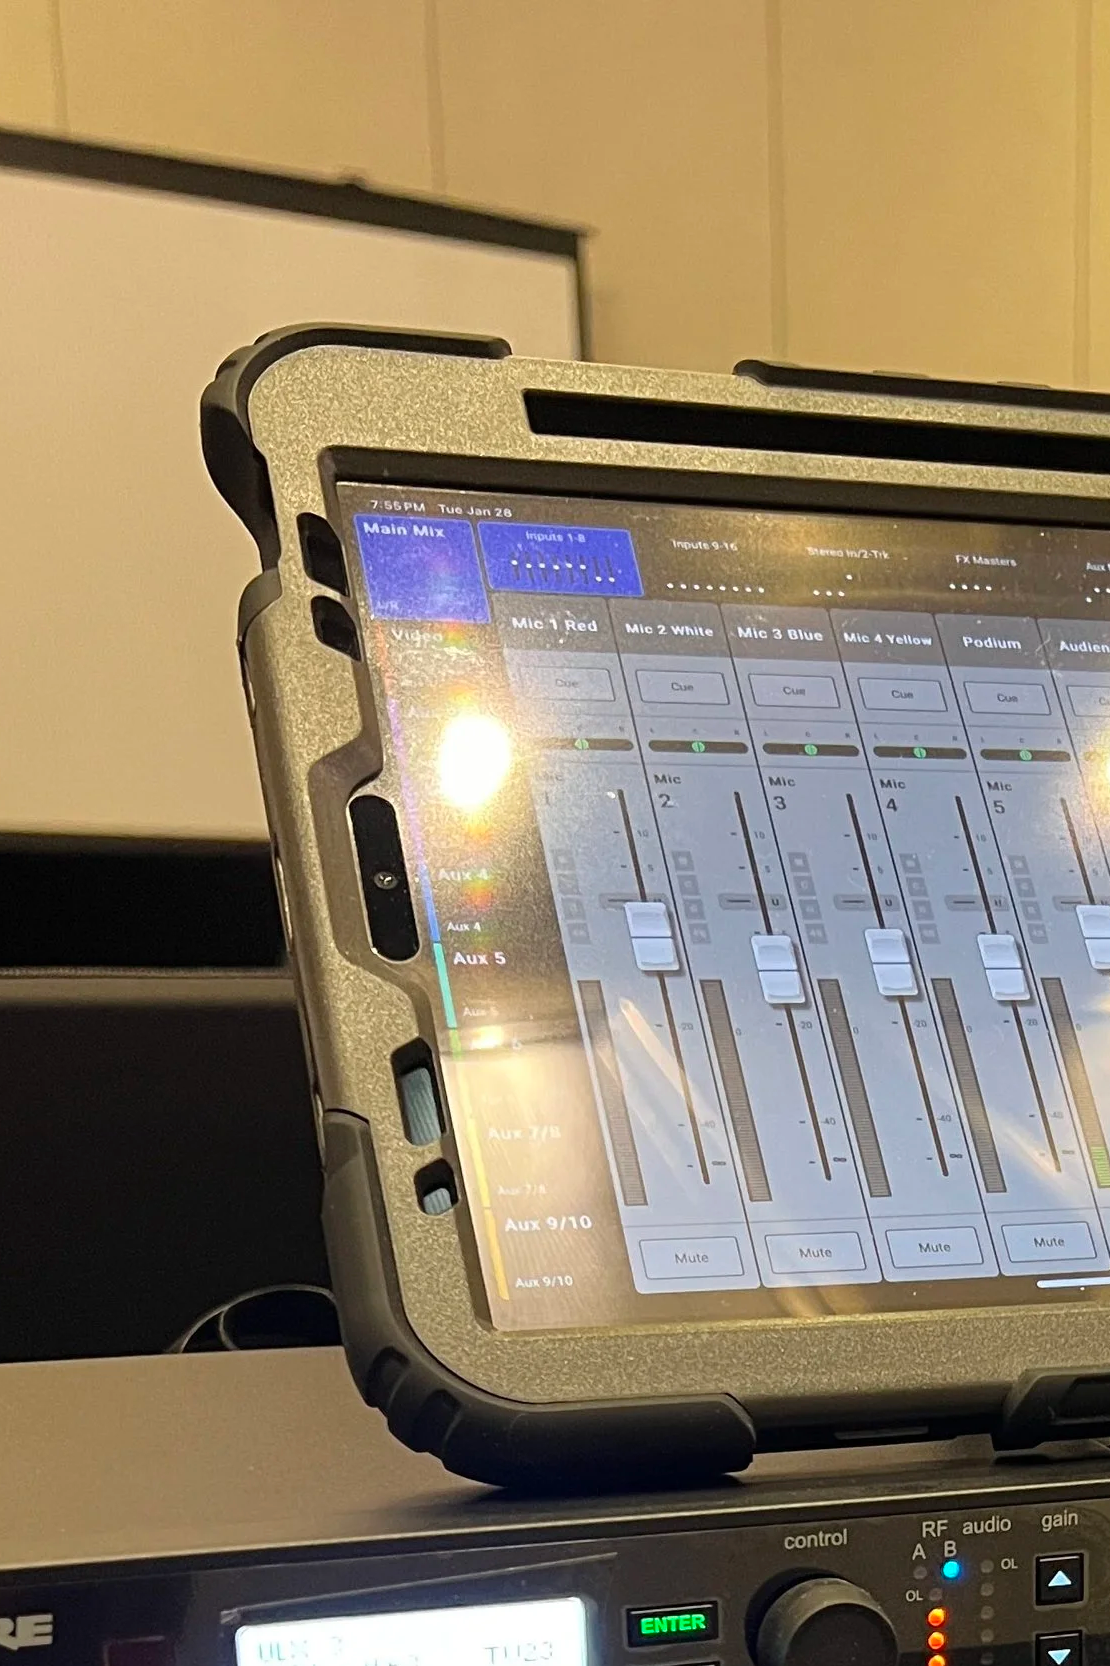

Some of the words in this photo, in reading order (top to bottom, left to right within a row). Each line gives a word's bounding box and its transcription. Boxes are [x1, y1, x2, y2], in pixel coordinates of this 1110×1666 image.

[439, 504, 463, 515] Tue
[467, 506, 491, 517] Jan
[494, 508, 513, 518] 28
[363, 522, 408, 536] Main
[413, 524, 446, 538] Mix
[525, 530, 563, 543] Inputs
[955, 554, 970, 564] FX
[972, 555, 1017, 567] Masters
[1086, 562, 1105, 572] Aux
[512, 617, 543, 631] Mic
[565, 620, 598, 632] Red
[626, 624, 652, 635] Mic
[657, 625, 666, 636] 2
[670, 626, 713, 638] White
[738, 627, 768, 640] Mic
[773, 629, 783, 640] 3
[788, 629, 823, 642] Blue
[844, 632, 871, 643] Mic
[874, 633, 883, 644] 4
[886, 634, 933, 646] Yellow
[962, 636, 1021, 650] Podium
[671, 681, 694, 692] Cue
[447, 923, 469, 932] Aux
[473, 922, 482, 932] 4
[453, 953, 488, 966] Aux
[495, 952, 506, 965] 5
[505, 1218, 540, 1232] Aux
[546, 1215, 592, 1231] 9/10
[919, 1241, 951, 1254] Mute
[1033, 1236, 1065, 1249] Mute
[674, 1252, 709, 1265] Mute
[799, 1246, 833, 1259] Mute
[515, 1277, 539, 1288] Aux
[542, 1276, 573, 1287] 9/10
[921, 1519, 949, 1538] RF
[962, 1516, 1012, 1535] audio
[1041, 1510, 1078, 1530] gain
[784, 1528, 848, 1550] control
[640, 1614, 706, 1635] ENTER
